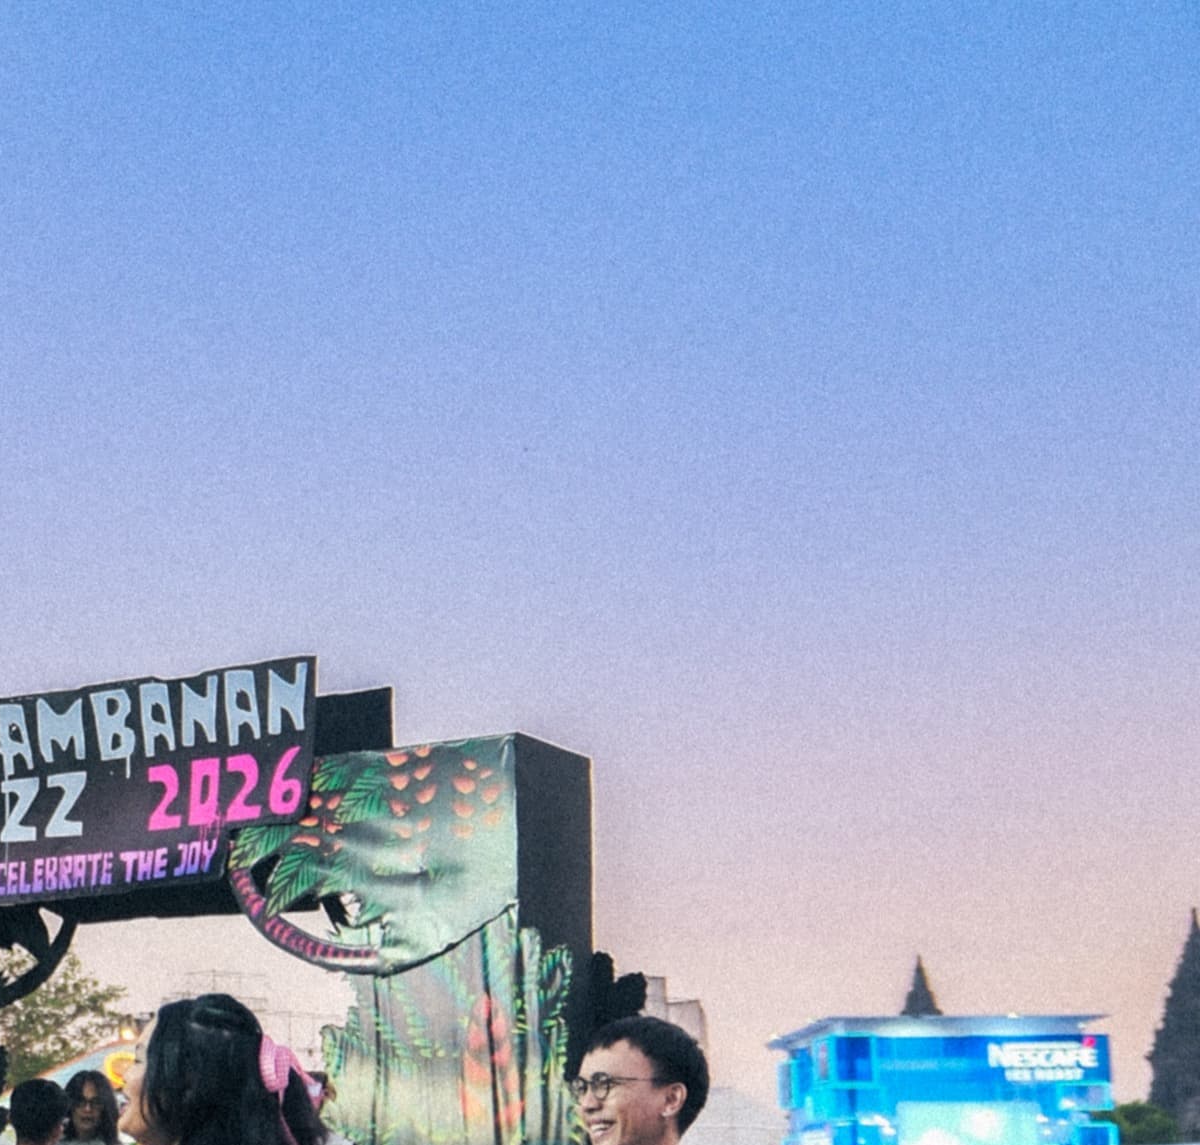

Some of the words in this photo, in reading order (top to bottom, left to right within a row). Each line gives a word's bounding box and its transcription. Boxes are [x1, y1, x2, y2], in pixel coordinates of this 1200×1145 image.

[147, 746, 302, 833] 2026
[120, 847, 168, 883] THE
[173, 840, 218, 877] JOY
